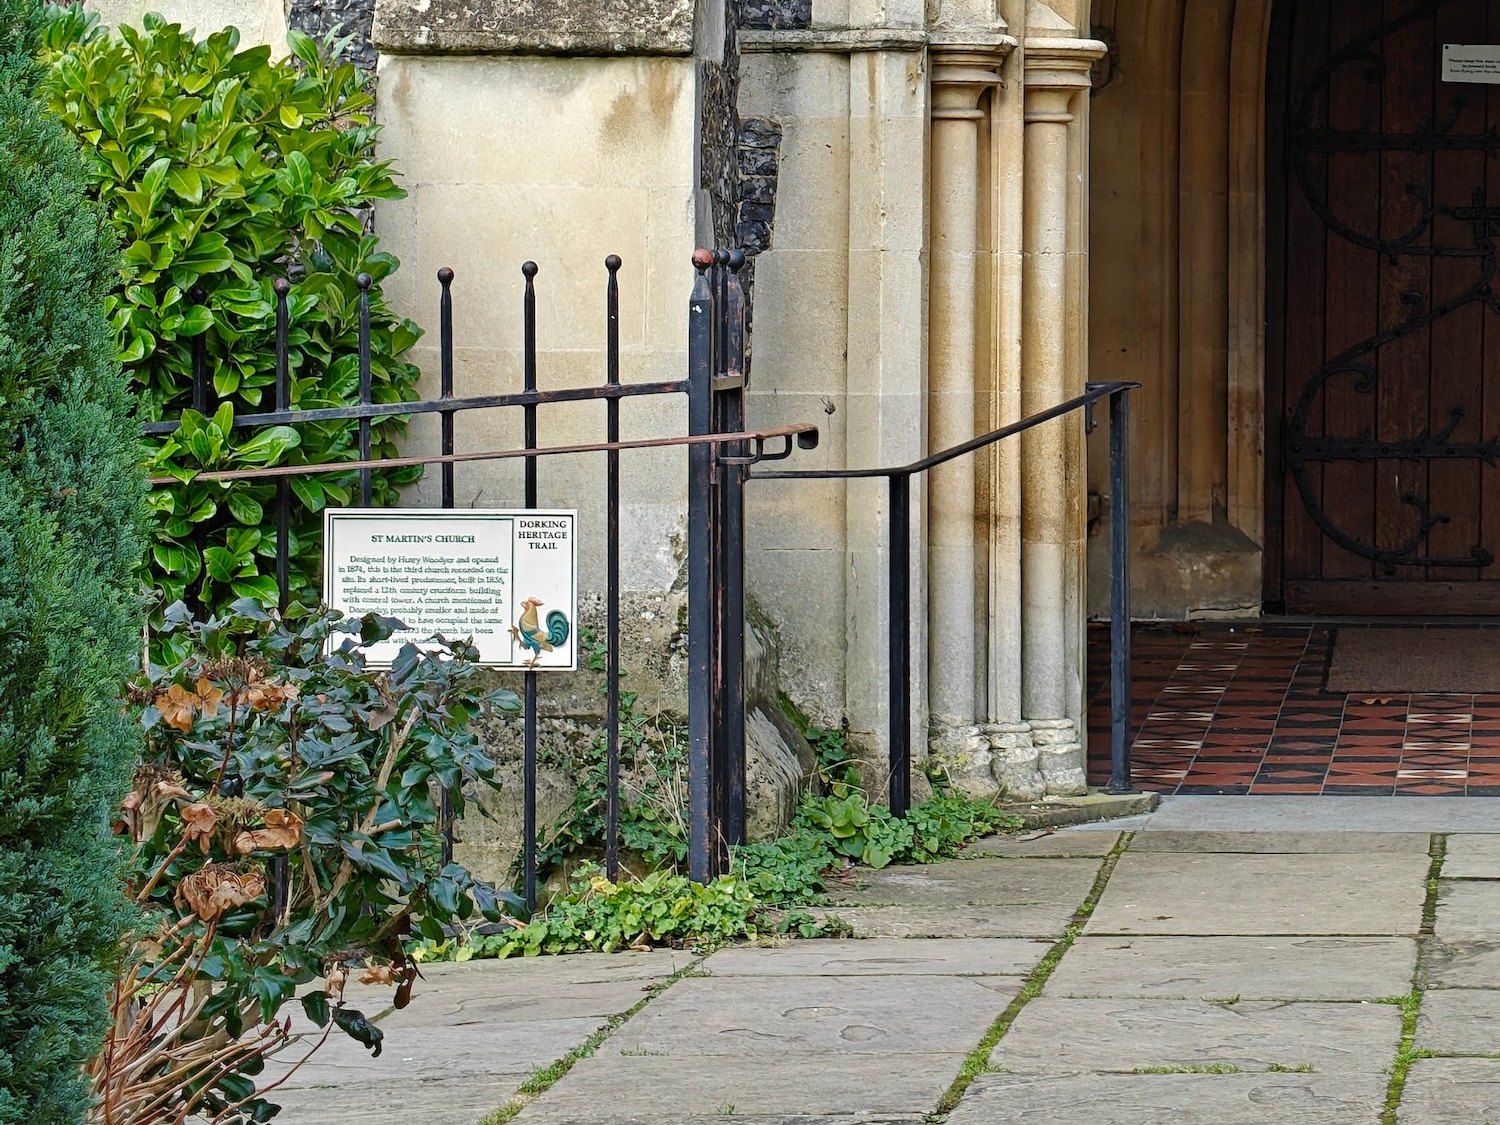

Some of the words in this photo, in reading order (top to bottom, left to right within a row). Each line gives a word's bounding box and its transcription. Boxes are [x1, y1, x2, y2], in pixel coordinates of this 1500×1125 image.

[519, 520, 567, 528] DORKING
[371, 535, 384, 543] ST
[385, 535, 433, 543] MARTIN'S
[435, 535, 475, 543] CHURCH
[518, 531, 568, 539] HERITAGE
[528, 542, 558, 550] TRAIL
[350, 556, 386, 564] Designed
[387, 556, 397, 565] by
[398, 556, 421, 565] Henry
